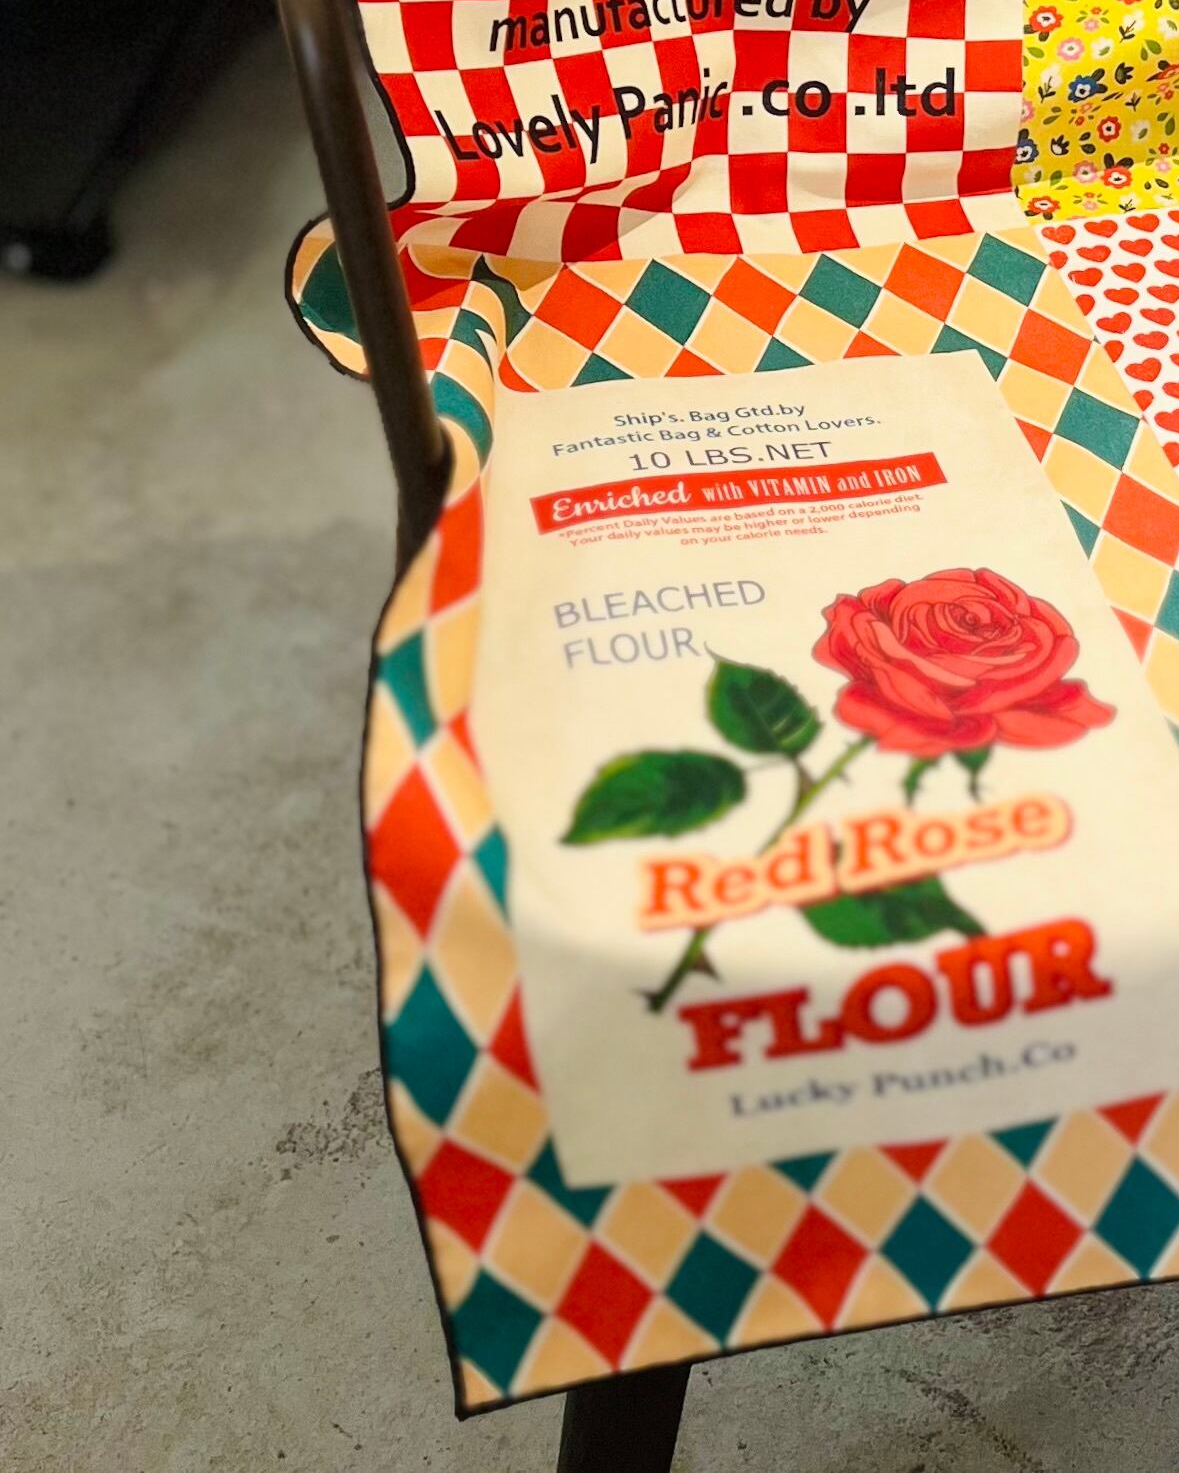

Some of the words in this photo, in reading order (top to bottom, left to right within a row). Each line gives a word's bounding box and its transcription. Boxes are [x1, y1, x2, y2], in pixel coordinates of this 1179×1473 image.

[434, 93, 600, 164] Lovely
[552, 430, 655, 456] Fantastic
[658, 429, 700, 441] Bag
[706, 427, 722, 438] &
[727, 422, 801, 437] Cotton
[805, 415, 881, 431] Lovers.
[613, 411, 685, 427] Ship's.
[689, 410, 730, 423] Bag
[628, 451, 671, 471] 10
[685, 441, 832, 467] LBS.NET
[552, 481, 692, 521] Enriched
[702, 481, 744, 503] with
[747, 475, 831, 497] VITAMIN
[837, 472, 872, 492] and
[874, 465, 922, 488] IRON
[623, 518, 658, 529] Daily
[661, 515, 707, 525] Values
[710, 513, 731, 522] are
[734, 509, 775, 521] based
[779, 507, 796, 516] on
[848, 498, 891, 510] calorie
[607, 529, 641, 540] daily
[644, 527, 689, 536] values
[692, 525, 721, 534] may
[744, 518, 788, 531] higher
[808, 512, 846, 523] lower
[848, 504, 921, 520] depending
[680, 537, 698, 546] on
[702, 535, 733, 546] your
[736, 530, 782, 540] calorie
[554, 579, 766, 629] BLEACHED
[563, 627, 701, 669] FLOUR
[641, 828, 817, 922] Red
[843, 798, 1055, 878] Rose
[678, 917, 1113, 1073] FLOUR
[730, 1069, 857, 1118] Lucky
